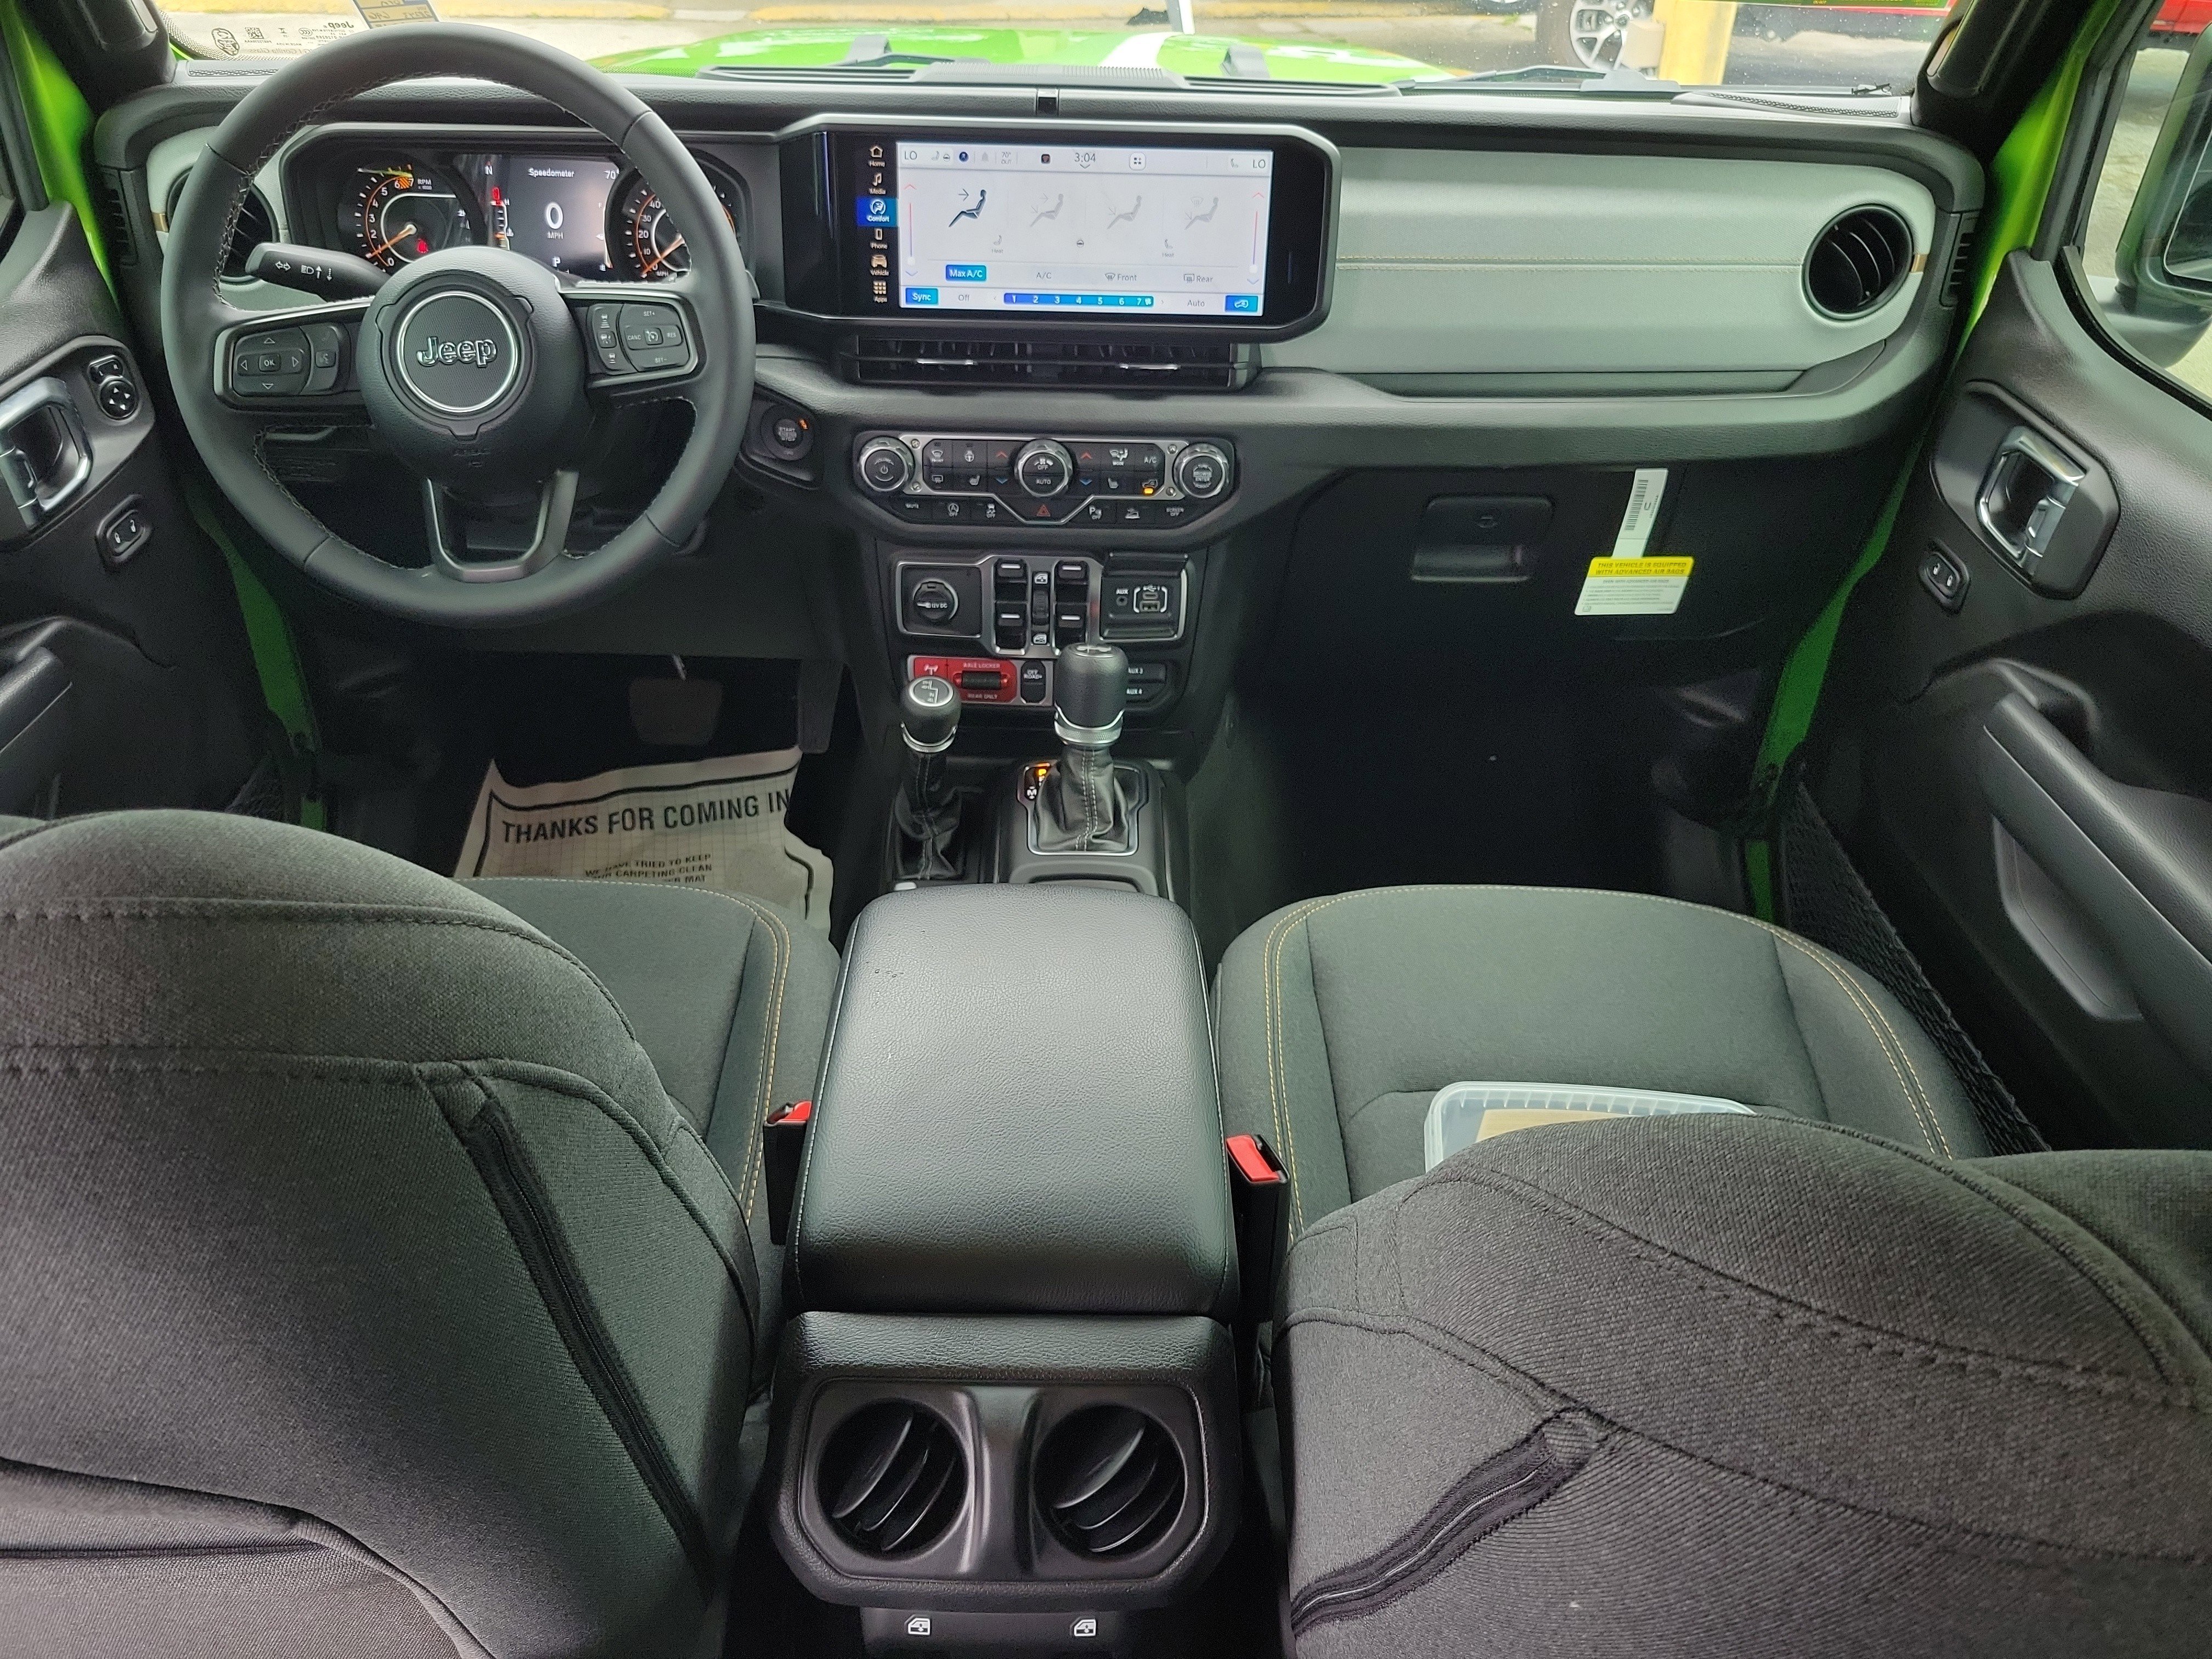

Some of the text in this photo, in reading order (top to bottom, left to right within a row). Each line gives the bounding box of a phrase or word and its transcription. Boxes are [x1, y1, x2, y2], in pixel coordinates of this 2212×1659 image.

[905, 151, 917, 160] LO
[1074, 153, 1096, 162] 3:04
[1252, 159, 1266, 168] LO
[485, 165, 493, 175] N
[528, 167, 574, 178] Speedometer
[394, 180, 400, 189] 6
[381, 187, 388, 196] 5
[373, 199, 379, 208] 4
[650, 200, 661, 209] 40
[369, 213, 375, 223] 3
[546, 202, 563, 229] 0
[371, 230, 377, 239] 2
[548, 231, 563, 240] MPH
[639, 230, 648, 238] 20
[387, 258, 394, 266] 0
[552, 256, 561, 267] P
[950, 269, 966, 278] Max
[912, 292, 932, 302] Sync
[1032, 296, 1039, 304] 2
[1054, 296, 1060, 304] 3
[1075, 296, 1082, 304] 4
[416, 336, 498, 367] Jeep
[503, 788, 790, 844] THANKS FOR COMING IN
[635, 859, 665, 868] TRIED
[669, 858, 681, 866] TO
[685, 853, 711, 864] KEEP
[616, 867, 675, 878] CARPETING
[679, 864, 712, 874] CLEAN
[685, 874, 706, 883] MAT
